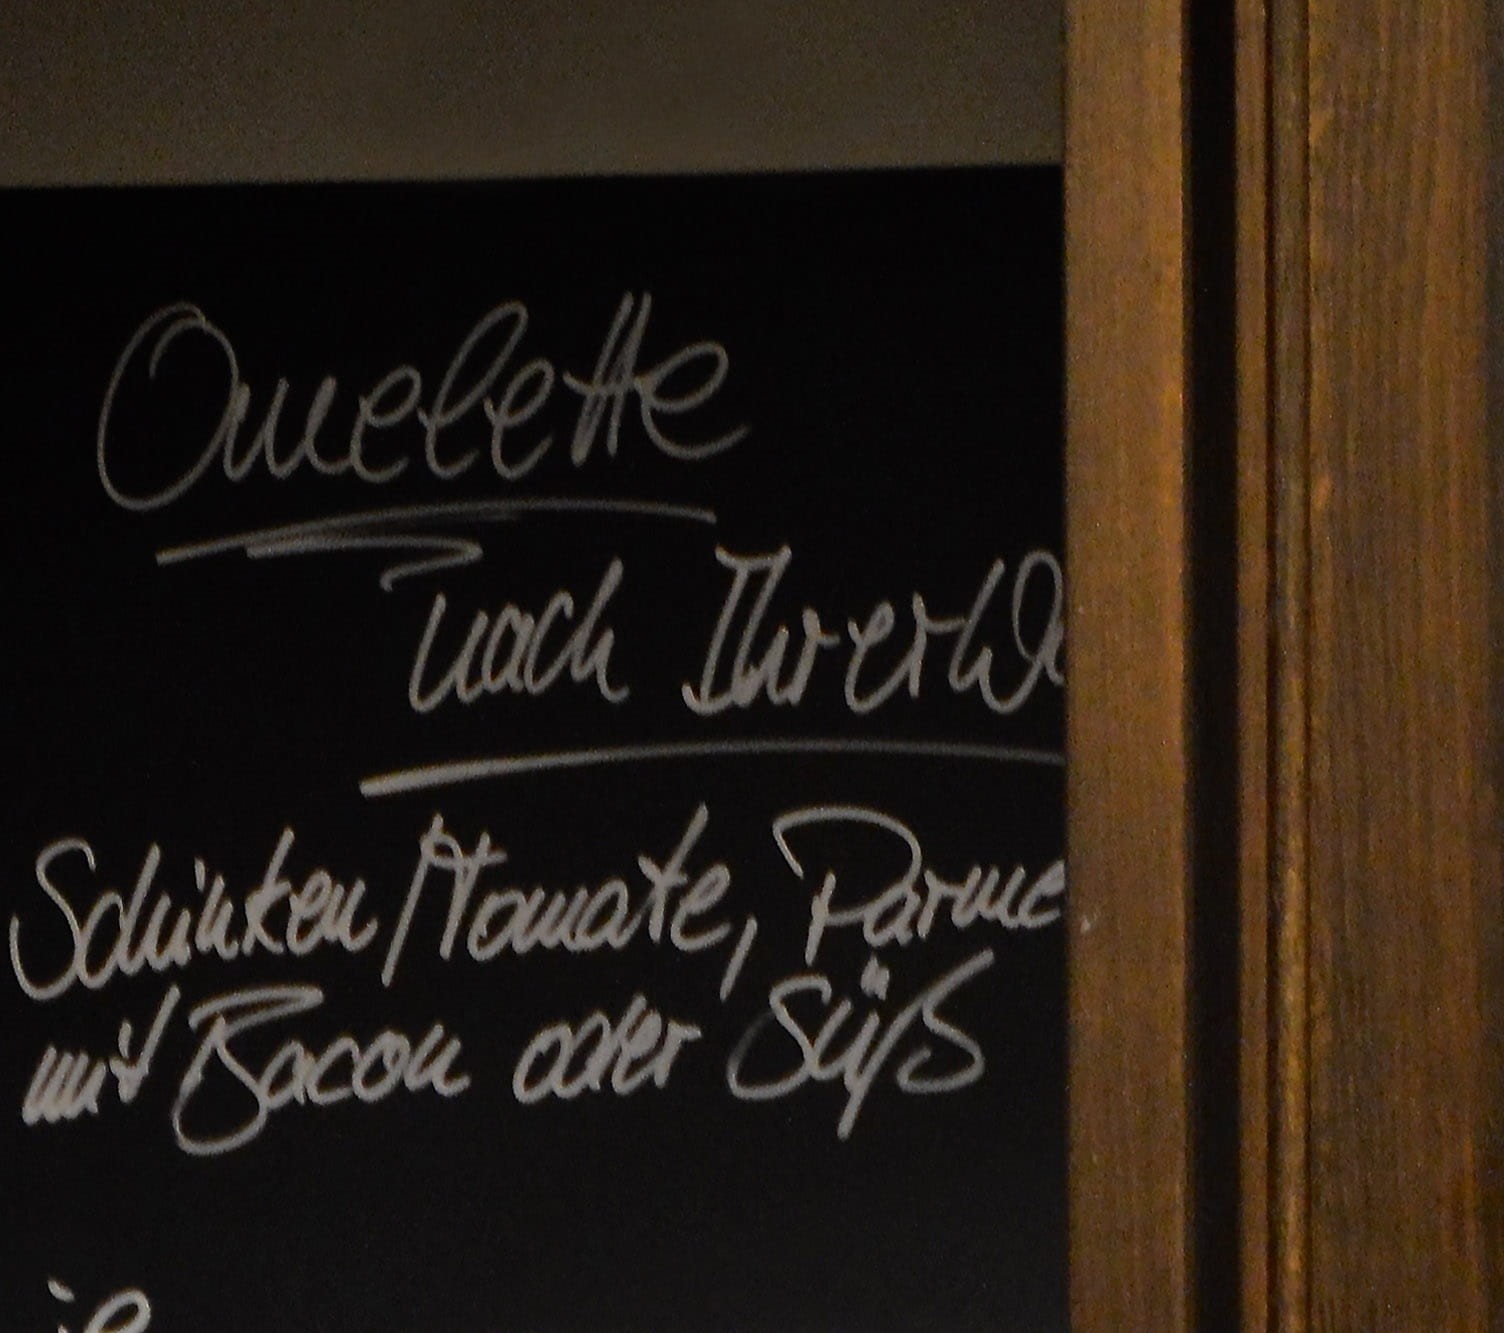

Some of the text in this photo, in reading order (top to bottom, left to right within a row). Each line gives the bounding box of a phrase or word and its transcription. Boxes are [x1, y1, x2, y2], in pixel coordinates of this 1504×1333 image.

[96, 290, 750, 512] Omelette
[408, 556, 631, 713] nach
[22, 984, 181, 1126] mit
[171, 984, 472, 1156] Bacon
[512, 994, 703, 1104] oder
